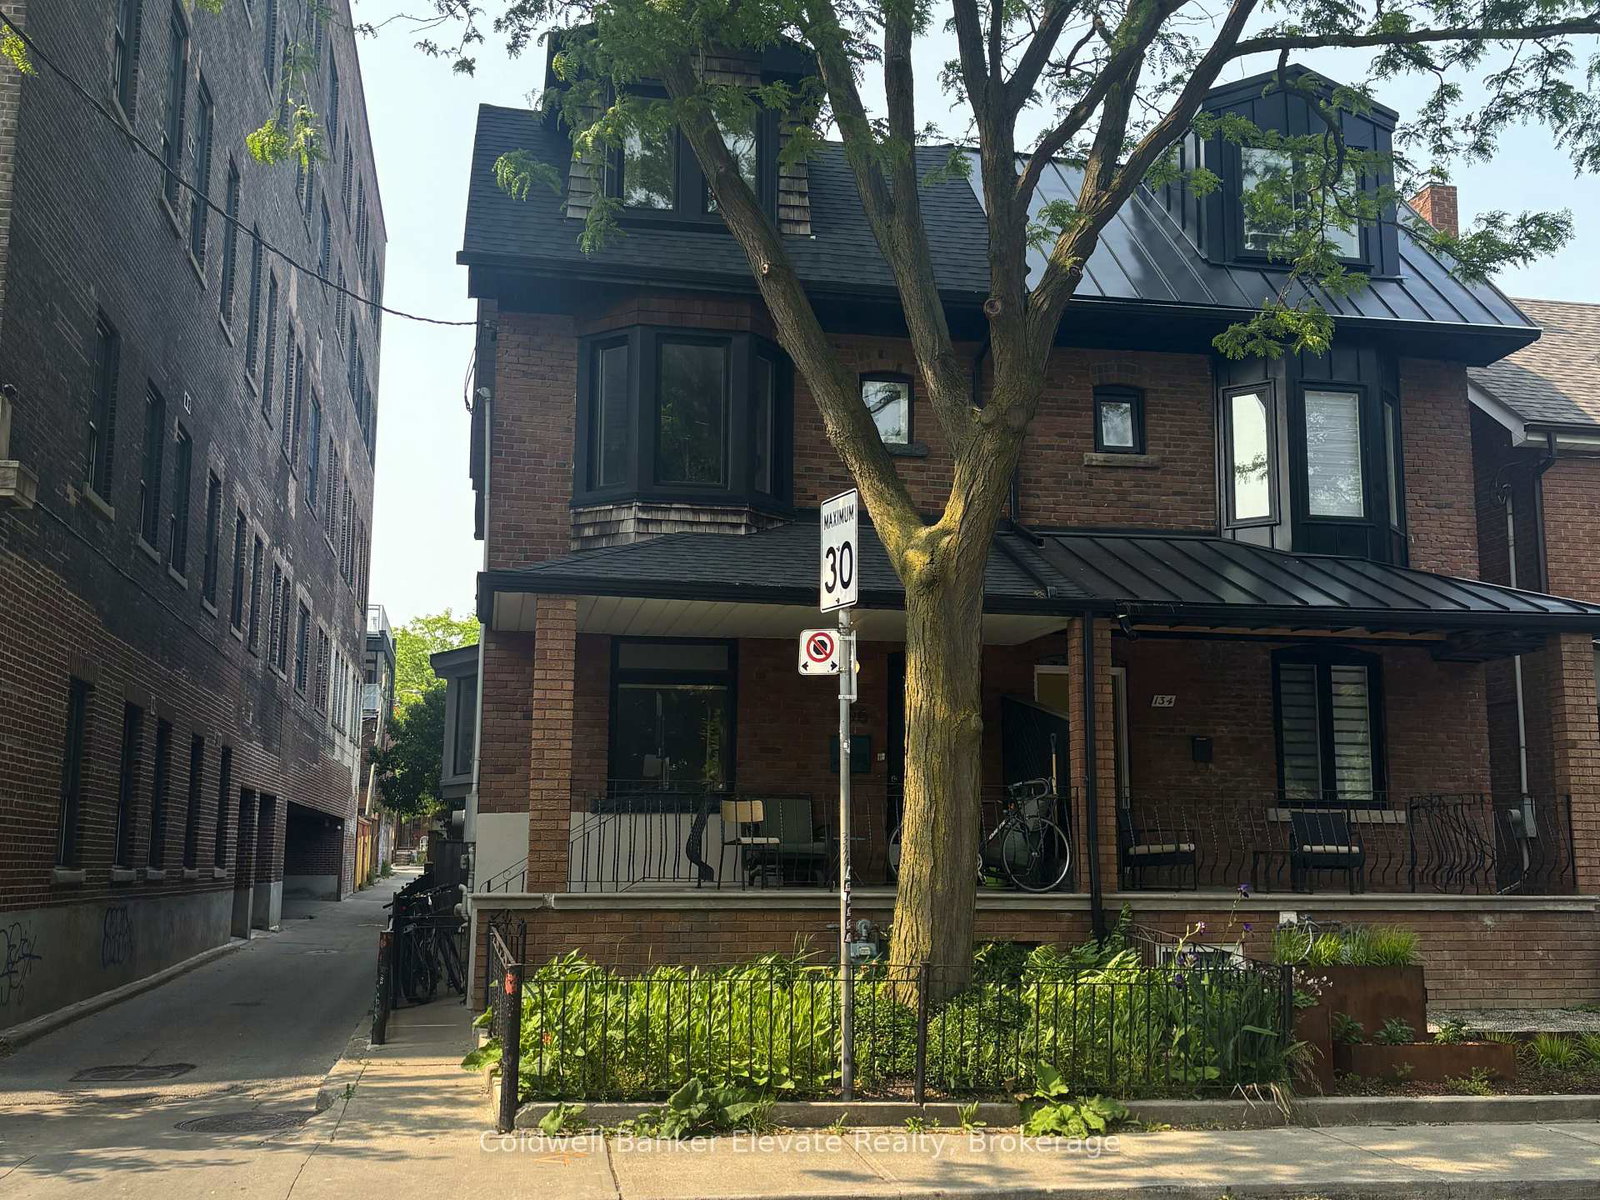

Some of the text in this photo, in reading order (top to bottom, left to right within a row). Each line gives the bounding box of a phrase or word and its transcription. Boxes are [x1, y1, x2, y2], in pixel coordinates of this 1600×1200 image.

[824, 503, 855, 531] MAXIMUM
[824, 540, 854, 594] 30
[1153, 696, 1174, 706] 134
